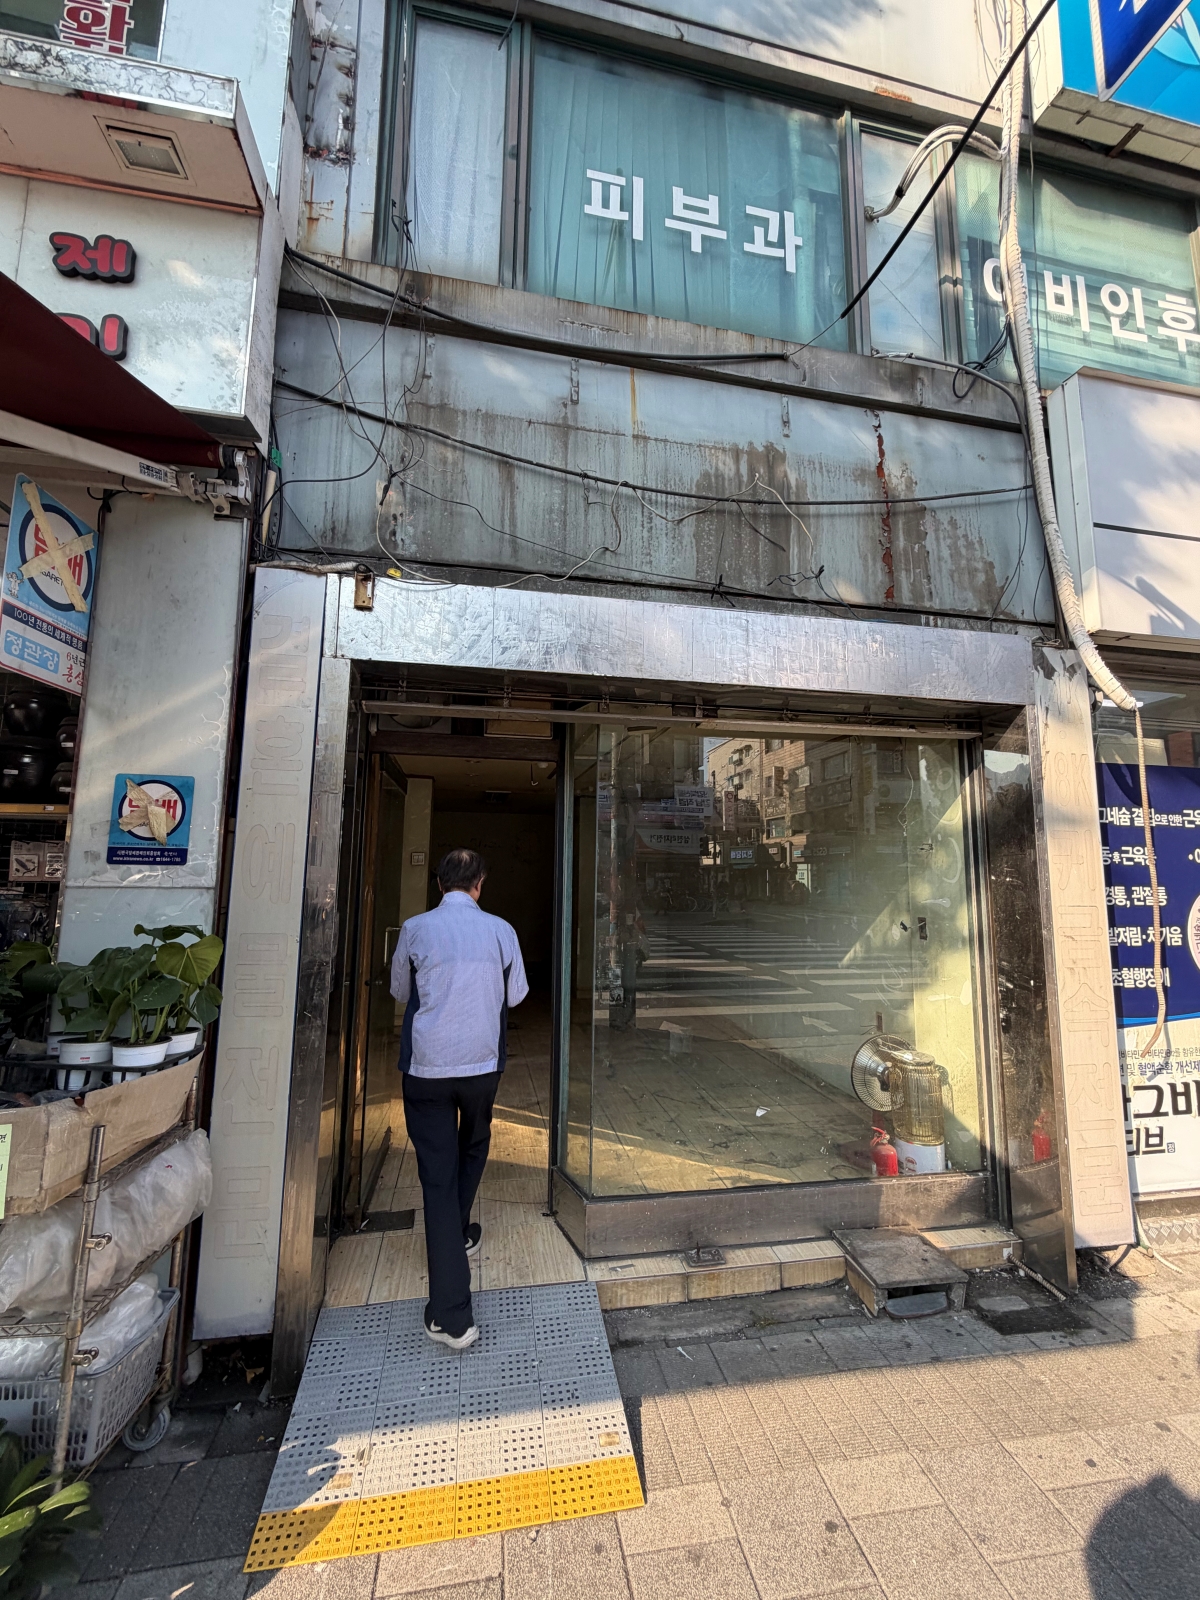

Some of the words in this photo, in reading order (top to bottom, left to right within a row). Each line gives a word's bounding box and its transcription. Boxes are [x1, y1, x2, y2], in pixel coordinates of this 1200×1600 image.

[49, 231, 136, 283] 제
[583, 168, 803, 274] 피부과
[6, 632, 59, 671] 정관장
[36, 620, 54, 637] 전통의
[1051, 828, 1110, 1048] 귀금속
[212, 1045, 280, 1260] 전문
[1065, 1060, 1125, 1217] 전문
